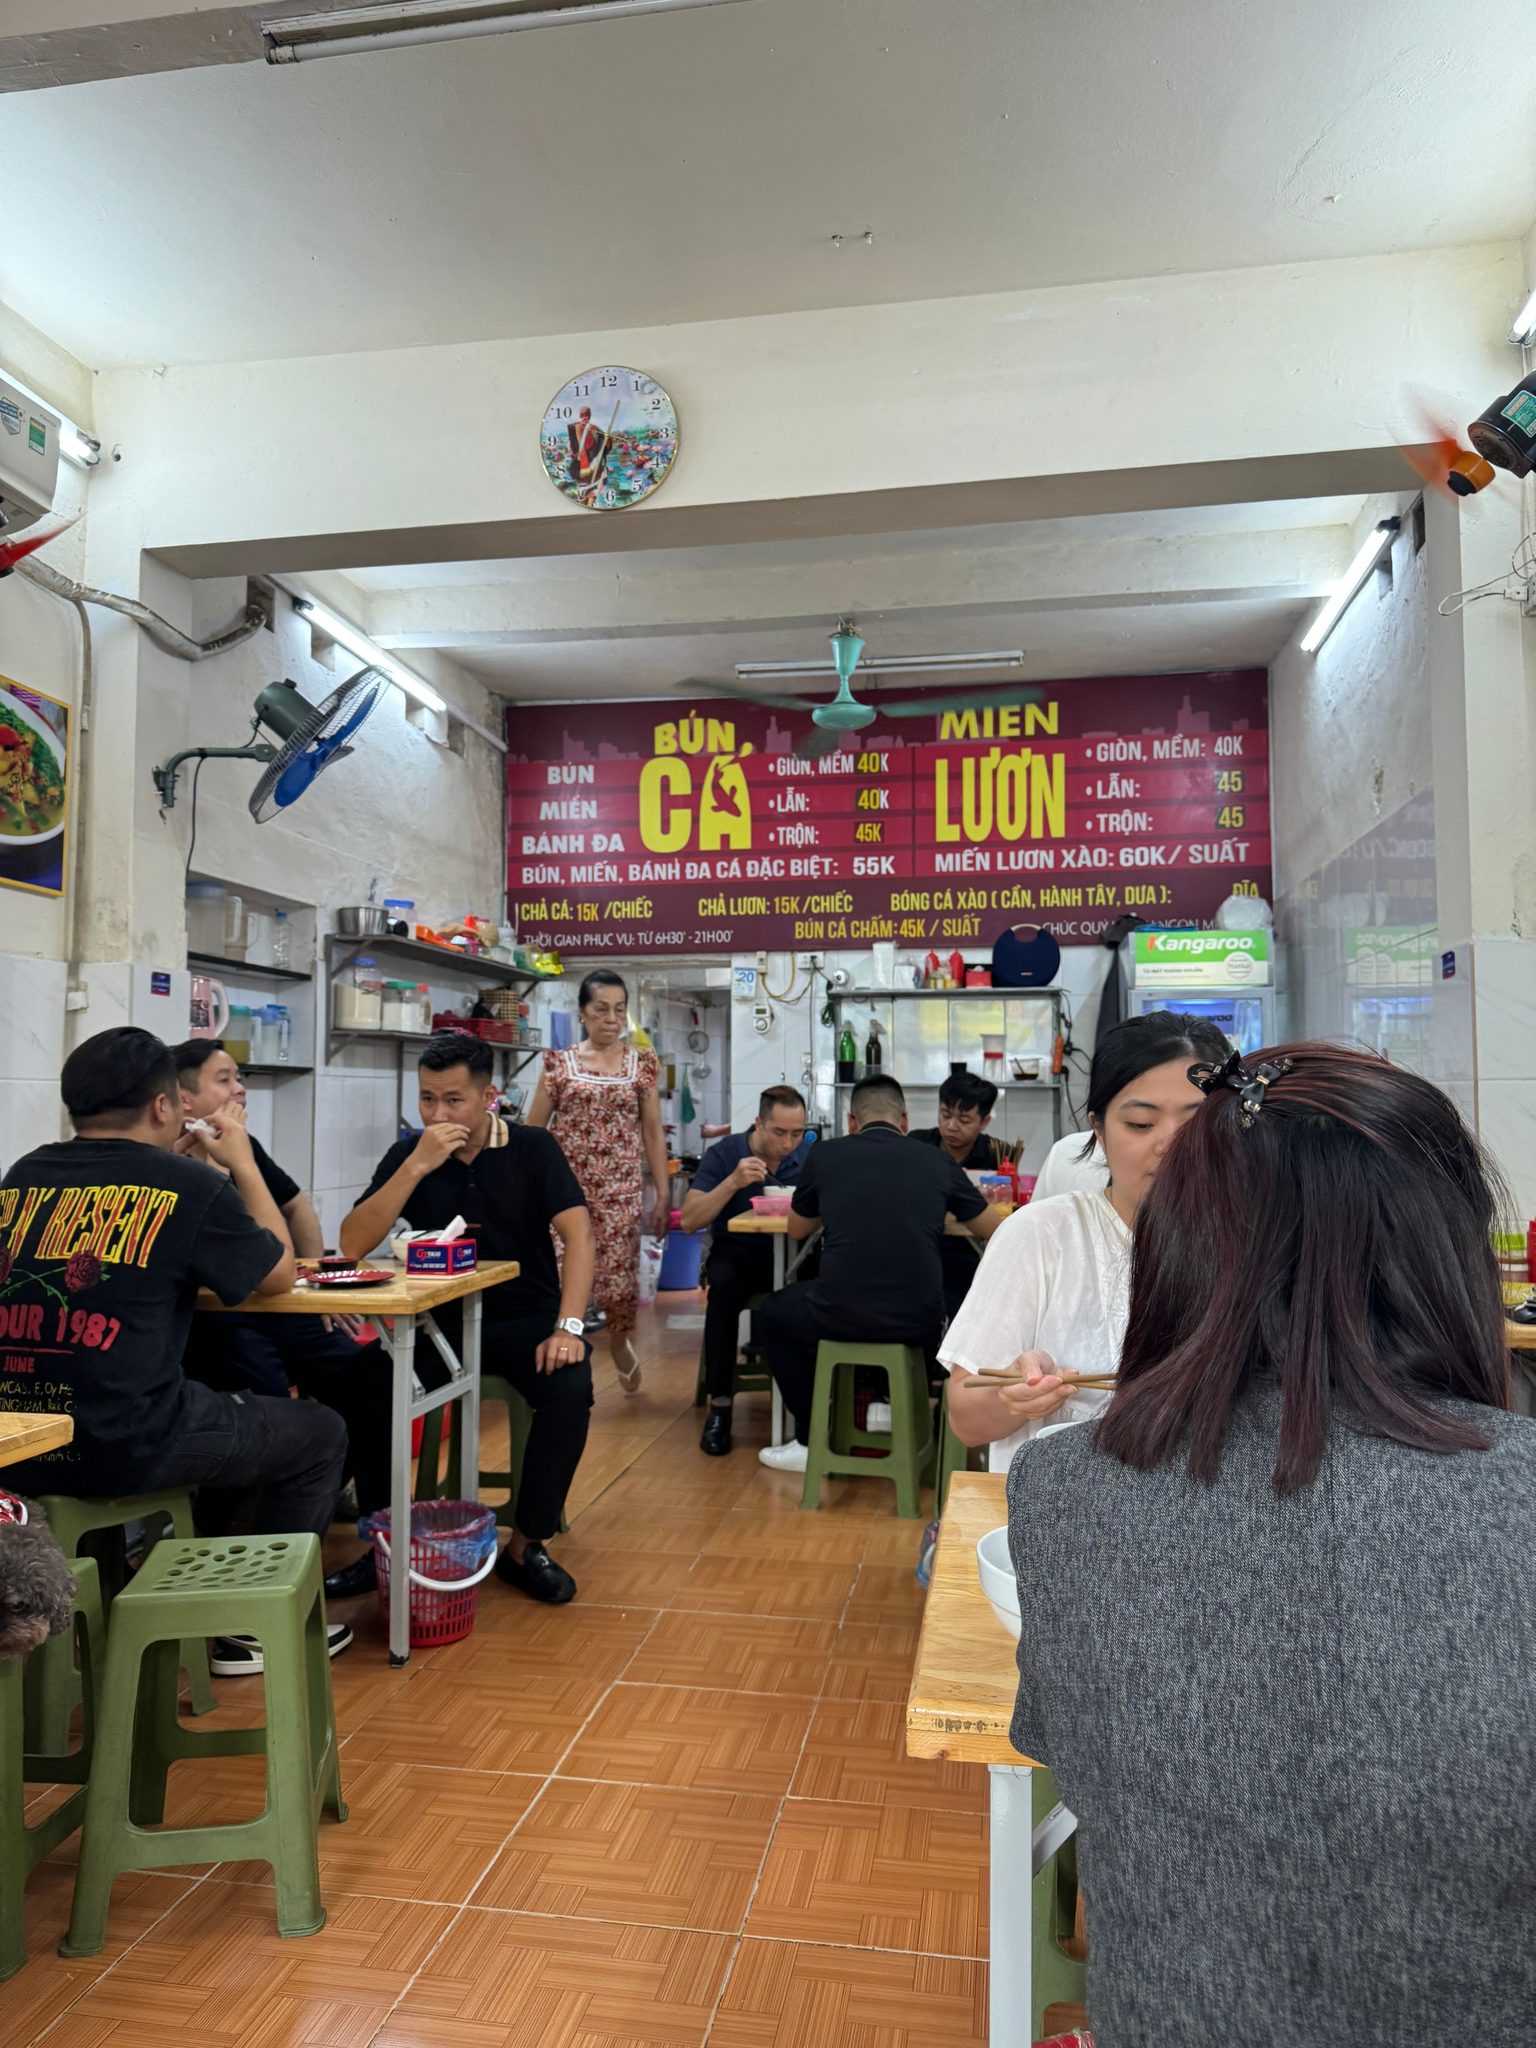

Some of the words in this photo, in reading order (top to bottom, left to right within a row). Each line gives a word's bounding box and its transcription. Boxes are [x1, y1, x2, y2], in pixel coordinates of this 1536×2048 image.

[574, 385, 591, 397] 11
[600, 375, 618, 388] 12
[633, 380, 641, 392] 1
[555, 407, 573, 419] 10
[651, 399, 661, 410] 2
[548, 436, 557, 447] 9
[659, 428, 669, 439] 3
[557, 465, 566, 477] 8
[651, 457, 662, 468] 4
[605, 491, 615, 502] 6
[632, 480, 642, 492] 5
[654, 710, 736, 755] BÚN
[1096, 738, 1147, 762] GIÒN,
[1152, 733, 1206, 760] MỀM:
[1214, 735, 1243, 756] 40K
[547, 761, 595, 784] BÚN
[857, 752, 889, 773] 40K
[935, 747, 1066, 842] LƯƠN
[1096, 772, 1141, 799] LẪN:
[1217, 770, 1243, 792] 45
[639, 741, 753, 853] CÁ
[776, 786, 810, 812] LẪN:
[857, 788, 889, 810] 40K
[1095, 808, 1154, 836] TRỘN:
[1218, 806, 1244, 828] 45
[522, 832, 585, 855] BÁNH
[591, 832, 625, 853] ĐA
[776, 822, 819, 848] TRỘN:
[855, 822, 882, 842] 45K
[935, 847, 991, 873] MIẾN
[996, 848, 1055, 871] LƯƠN
[1061, 845, 1114, 868] XÀO:
[1188, 837, 1250, 864] SUẤT
[522, 864, 566, 885] BÚN,
[570, 860, 624, 884] MIẾN,
[628, 857, 680, 882] BÁNH
[684, 860, 712, 880] ĐA
[715, 857, 742, 879] CÁ
[746, 856, 786, 881] ĐẶC
[790, 854, 839, 879] BIỆT:
[852, 855, 896, 876] 55K
[698, 893, 726, 917] CHẢ
[773, 896, 800, 914] 15K
[890, 889, 931, 912] BÓNG
[933, 888, 954, 910] CÁ
[957, 887, 988, 909] XÀO
[1000, 884, 1037, 909] CẦN,
[1039, 884, 1082, 908] HÀNH
[1086, 883, 1121, 908] TÂY,
[1125, 885, 1156, 906] DƯA
[520, 897, 549, 922] CHẢ
[551, 899, 574, 921] CÁ:
[576, 902, 600, 922] 15K
[794, 918, 824, 939] BÚN
[827, 917, 847, 939] CÁ
[850, 915, 898, 938] CHẤM:
[899, 917, 926, 938] 45K
[942, 912, 981, 937] SUẤT
[554, 933, 582, 947] GIAN
[1148, 934, 1254, 954] Kangaroo
[740, 971, 754, 983] 20
[34, 1184, 179, 1268] RESENT
[56, 1306, 121, 1351] 1987
[3, 1356, 35, 1373] JUNE
